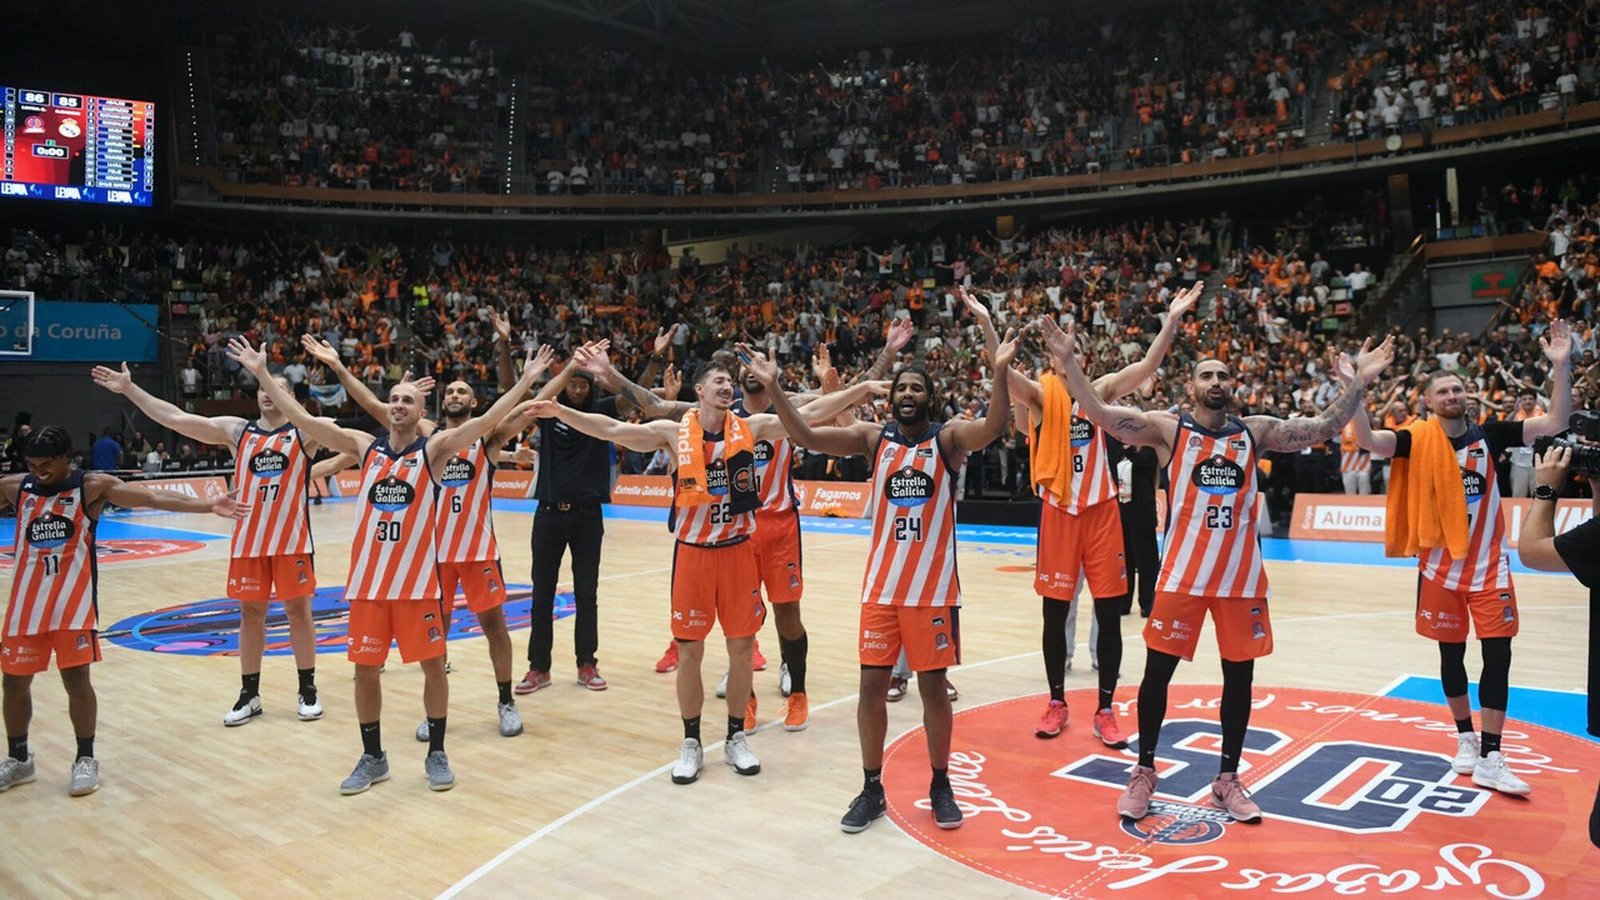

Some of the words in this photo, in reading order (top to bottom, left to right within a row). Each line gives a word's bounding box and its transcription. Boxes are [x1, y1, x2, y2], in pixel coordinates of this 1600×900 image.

[25, 92, 45, 104] 86
[59, 96, 78, 107] 85
[37, 147, 65, 157] 0:00
[47, 323, 122, 340] Coruña
[1070, 421, 1090, 431] trella
[678, 414, 695, 466] enda
[254, 455, 283, 466] Estrella
[255, 462, 282, 472] Galicia
[1200, 465, 1237, 477] Estrella
[890, 477, 927, 487] Estrella
[1201, 474, 1236, 486] Galicia
[259, 484, 280, 502] 77
[375, 484, 408, 495] Estrella
[615, 484, 641, 495] Estrella
[641, 487, 667, 497] Galicia
[815, 487, 862, 500] Fagamos
[891, 486, 926, 497] Galicia
[375, 493, 406, 504] Galicia
[452, 495, 461, 514] 6
[710, 503, 733, 525] 22
[1206, 505, 1233, 529] 23
[1322, 511, 1382, 527] Aluma
[31, 521, 67, 533] Estrella
[377, 521, 401, 542] 30
[894, 516, 922, 541] 24
[31, 530, 66, 541] Galicia
[43, 554, 60, 577] 11
[1000, 825, 1229, 890] Jesús
[1220, 843, 1546, 900] Grazas
